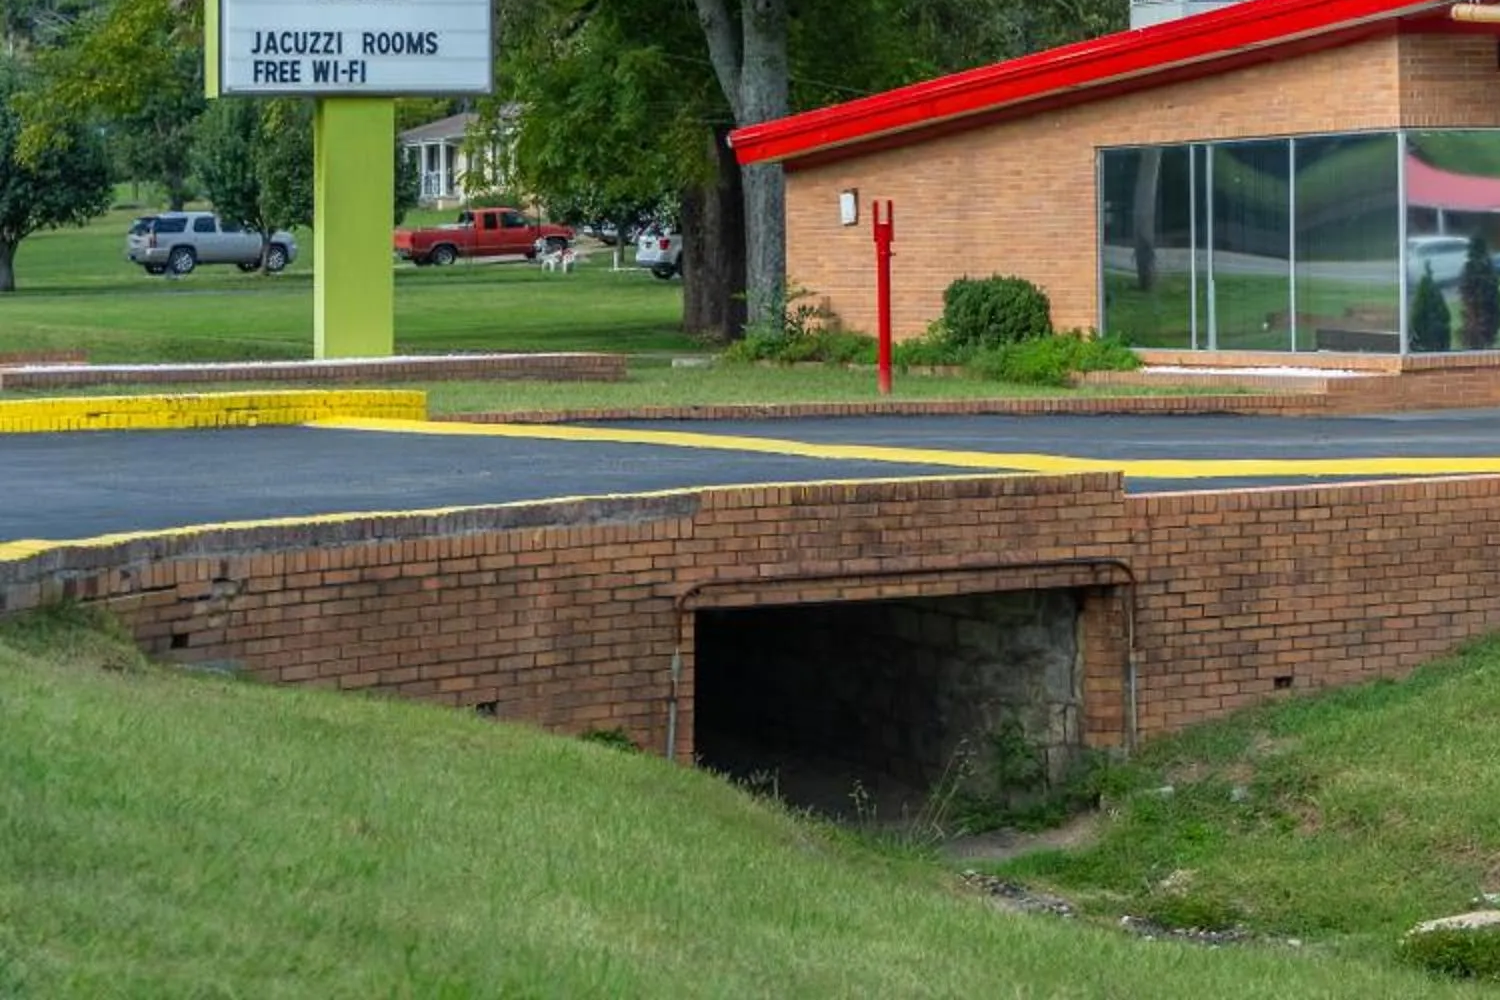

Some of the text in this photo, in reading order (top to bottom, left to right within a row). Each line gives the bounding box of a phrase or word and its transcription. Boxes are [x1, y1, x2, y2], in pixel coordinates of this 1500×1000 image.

[251, 32, 439, 56] JACUZZI ROOMS
[252, 60, 367, 84] FREE WI-FI
